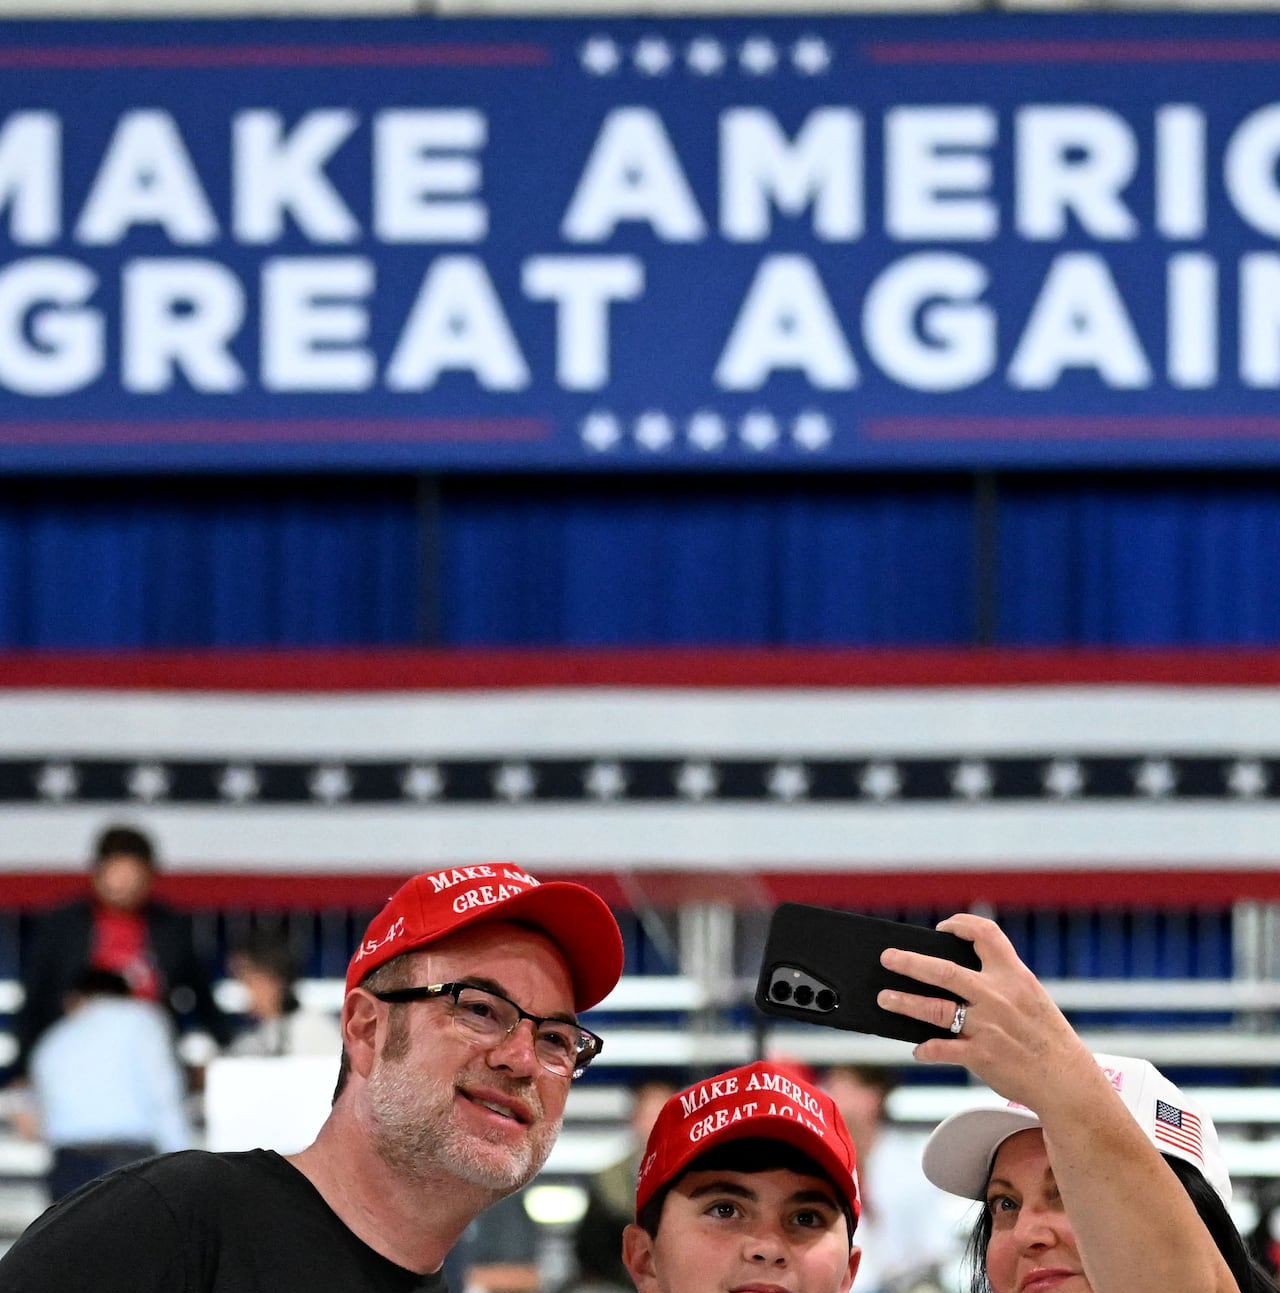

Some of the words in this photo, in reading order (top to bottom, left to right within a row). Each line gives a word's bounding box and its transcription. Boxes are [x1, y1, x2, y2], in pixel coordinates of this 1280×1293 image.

[428, 866, 497, 893] MAKE
[452, 883, 522, 914] GREAT
[680, 1077, 739, 1119] MAKE
[689, 1102, 758, 1142] GREAT
